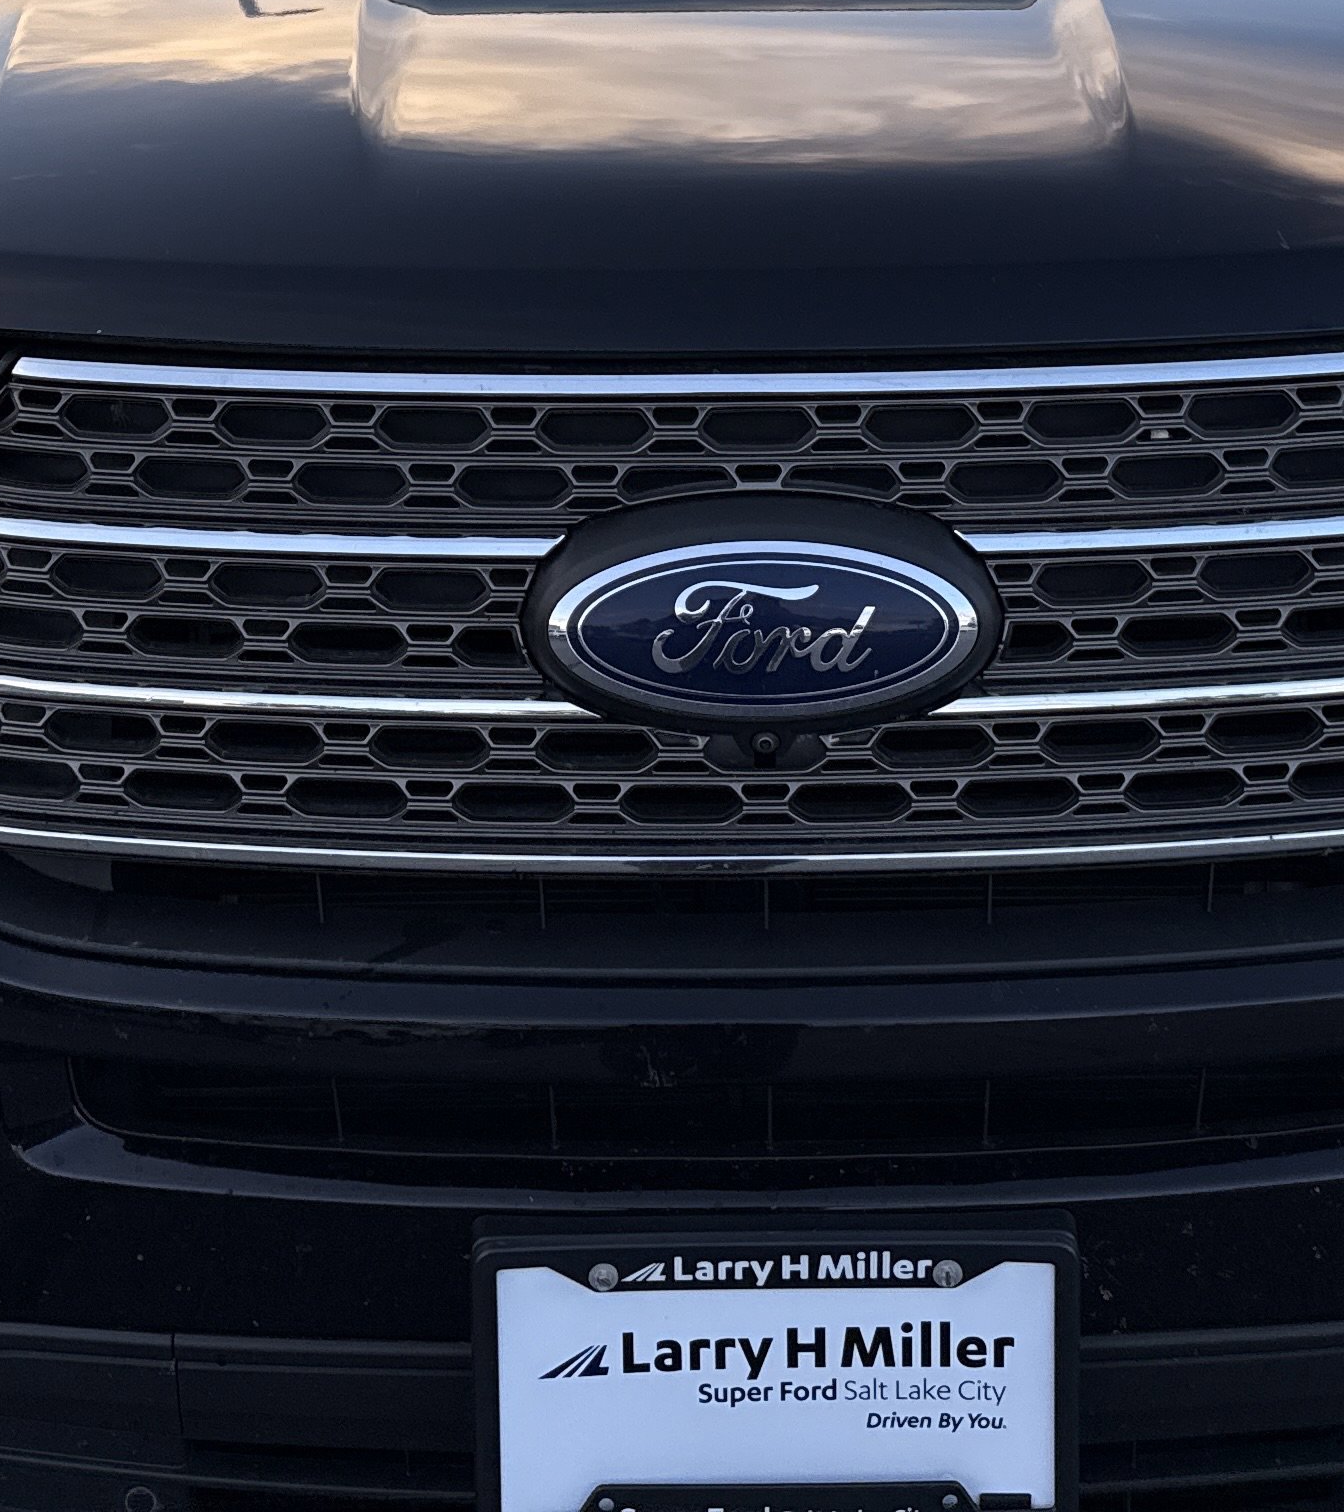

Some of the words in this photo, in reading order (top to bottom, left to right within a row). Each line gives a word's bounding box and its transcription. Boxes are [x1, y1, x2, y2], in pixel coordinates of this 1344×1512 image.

[652, 581, 875, 674] Ford
[673, 1256, 774, 1287] Larry
[781, 1255, 809, 1280] H
[817, 1251, 933, 1280] Miller
[622, 1332, 773, 1380] Larry
[786, 1327, 827, 1368] H
[840, 1321, 1015, 1368] Miller
[698, 1383, 774, 1408] Super
[780, 1379, 837, 1401] Ford
[844, 1379, 889, 1401] Salt
[895, 1378, 951, 1401] Lake
[958, 1379, 1007, 1406] City
[866, 1412, 932, 1429] Driven
[938, 1412, 964, 1432] By
